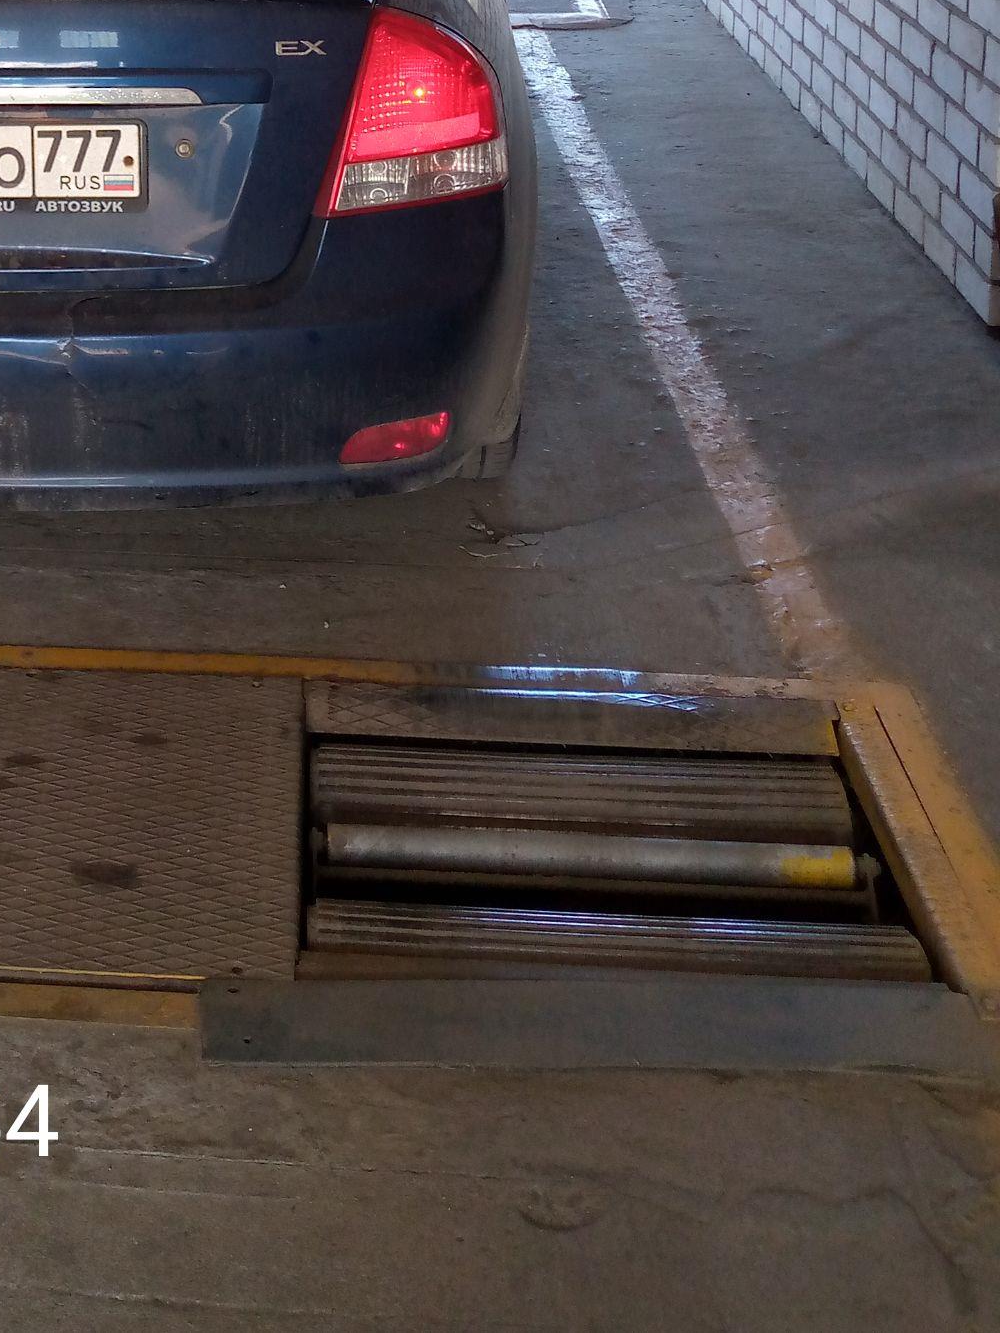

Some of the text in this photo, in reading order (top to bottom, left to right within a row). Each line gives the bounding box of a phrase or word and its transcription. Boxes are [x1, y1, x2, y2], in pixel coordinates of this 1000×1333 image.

[275, 40, 327, 56] EX
[37, 129, 122, 173] 777
[60, 175, 101, 191] RUS
[35, 200, 123, 213] АВТОЗВУК
